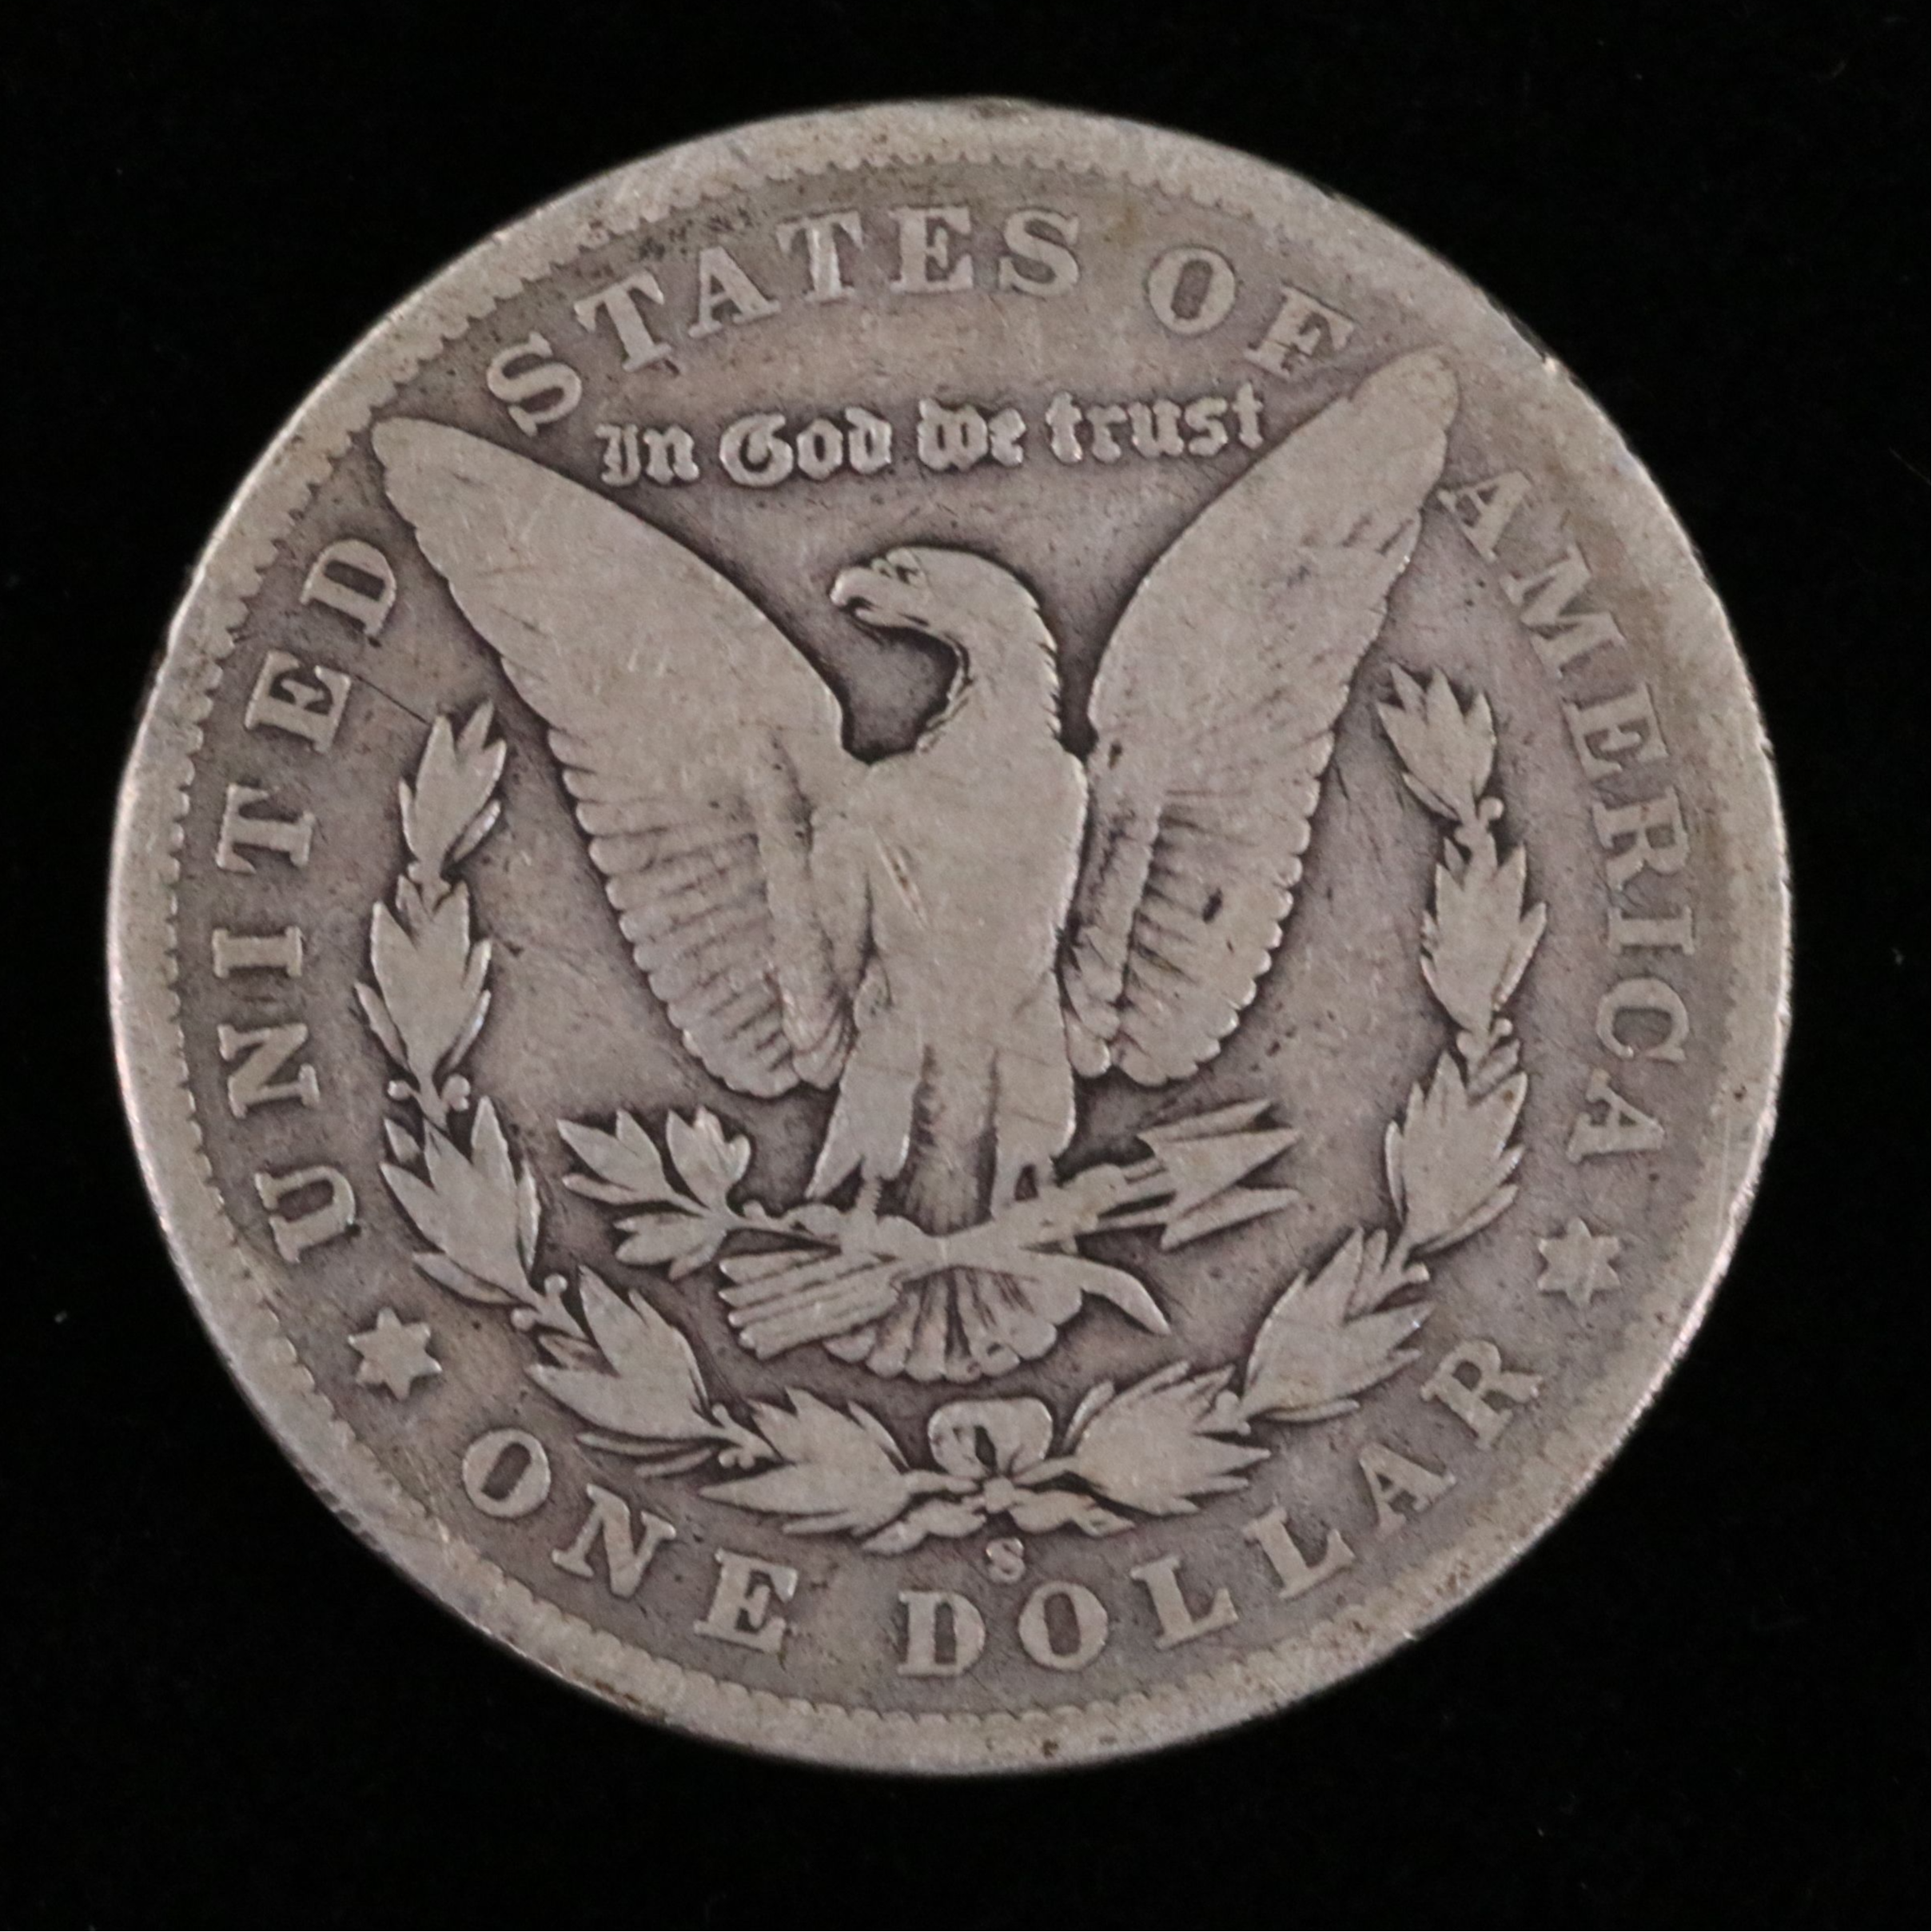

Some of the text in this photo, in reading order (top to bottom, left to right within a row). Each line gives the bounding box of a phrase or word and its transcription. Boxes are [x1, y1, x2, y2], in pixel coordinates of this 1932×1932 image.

[719, 410, 891, 488] God
[917, 399, 1026, 472] we
[1047, 383, 1266, 464] trust
[213, 206, 1694, 1263] UNITED STATES OF AMERICA
[461, 1340, 1539, 1677] ONE DOLLAR
[986, 1536, 1026, 1583] S
